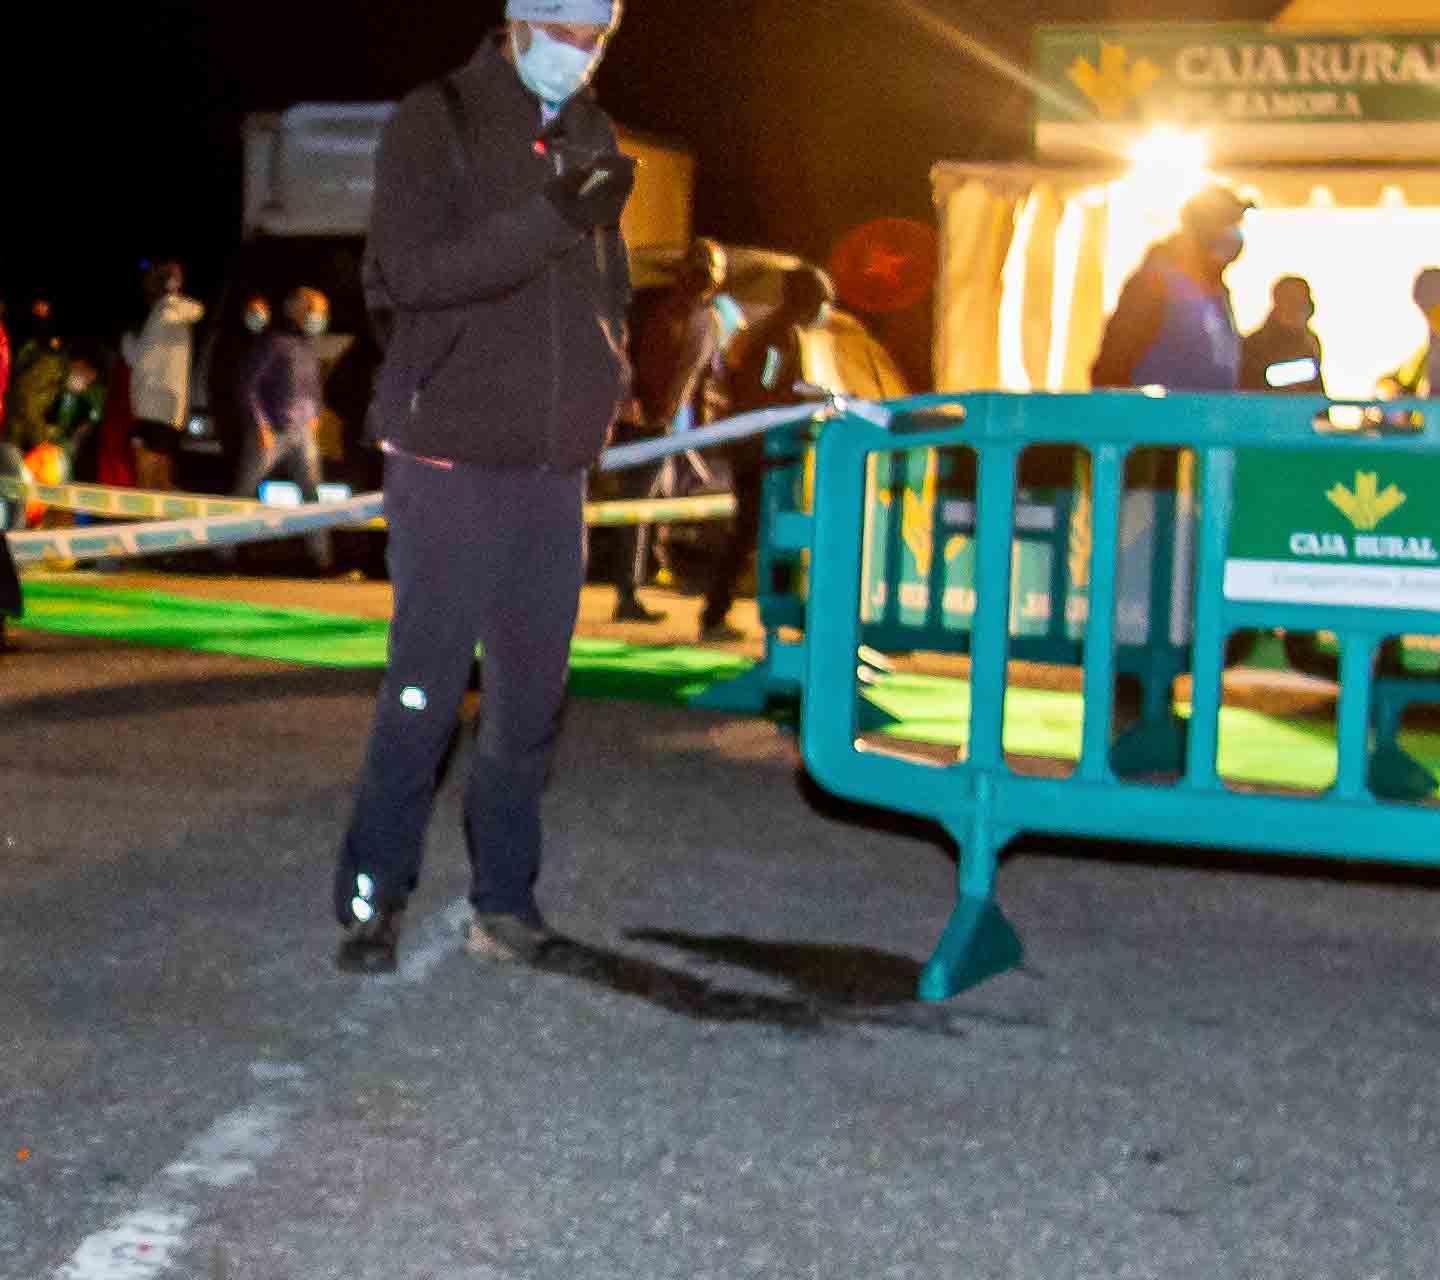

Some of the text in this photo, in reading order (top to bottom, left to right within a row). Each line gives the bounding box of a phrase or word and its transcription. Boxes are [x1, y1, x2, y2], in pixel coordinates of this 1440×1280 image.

[1175, 42, 1290, 84] CAJA
[1289, 531, 1440, 561] CAJA RURAL
